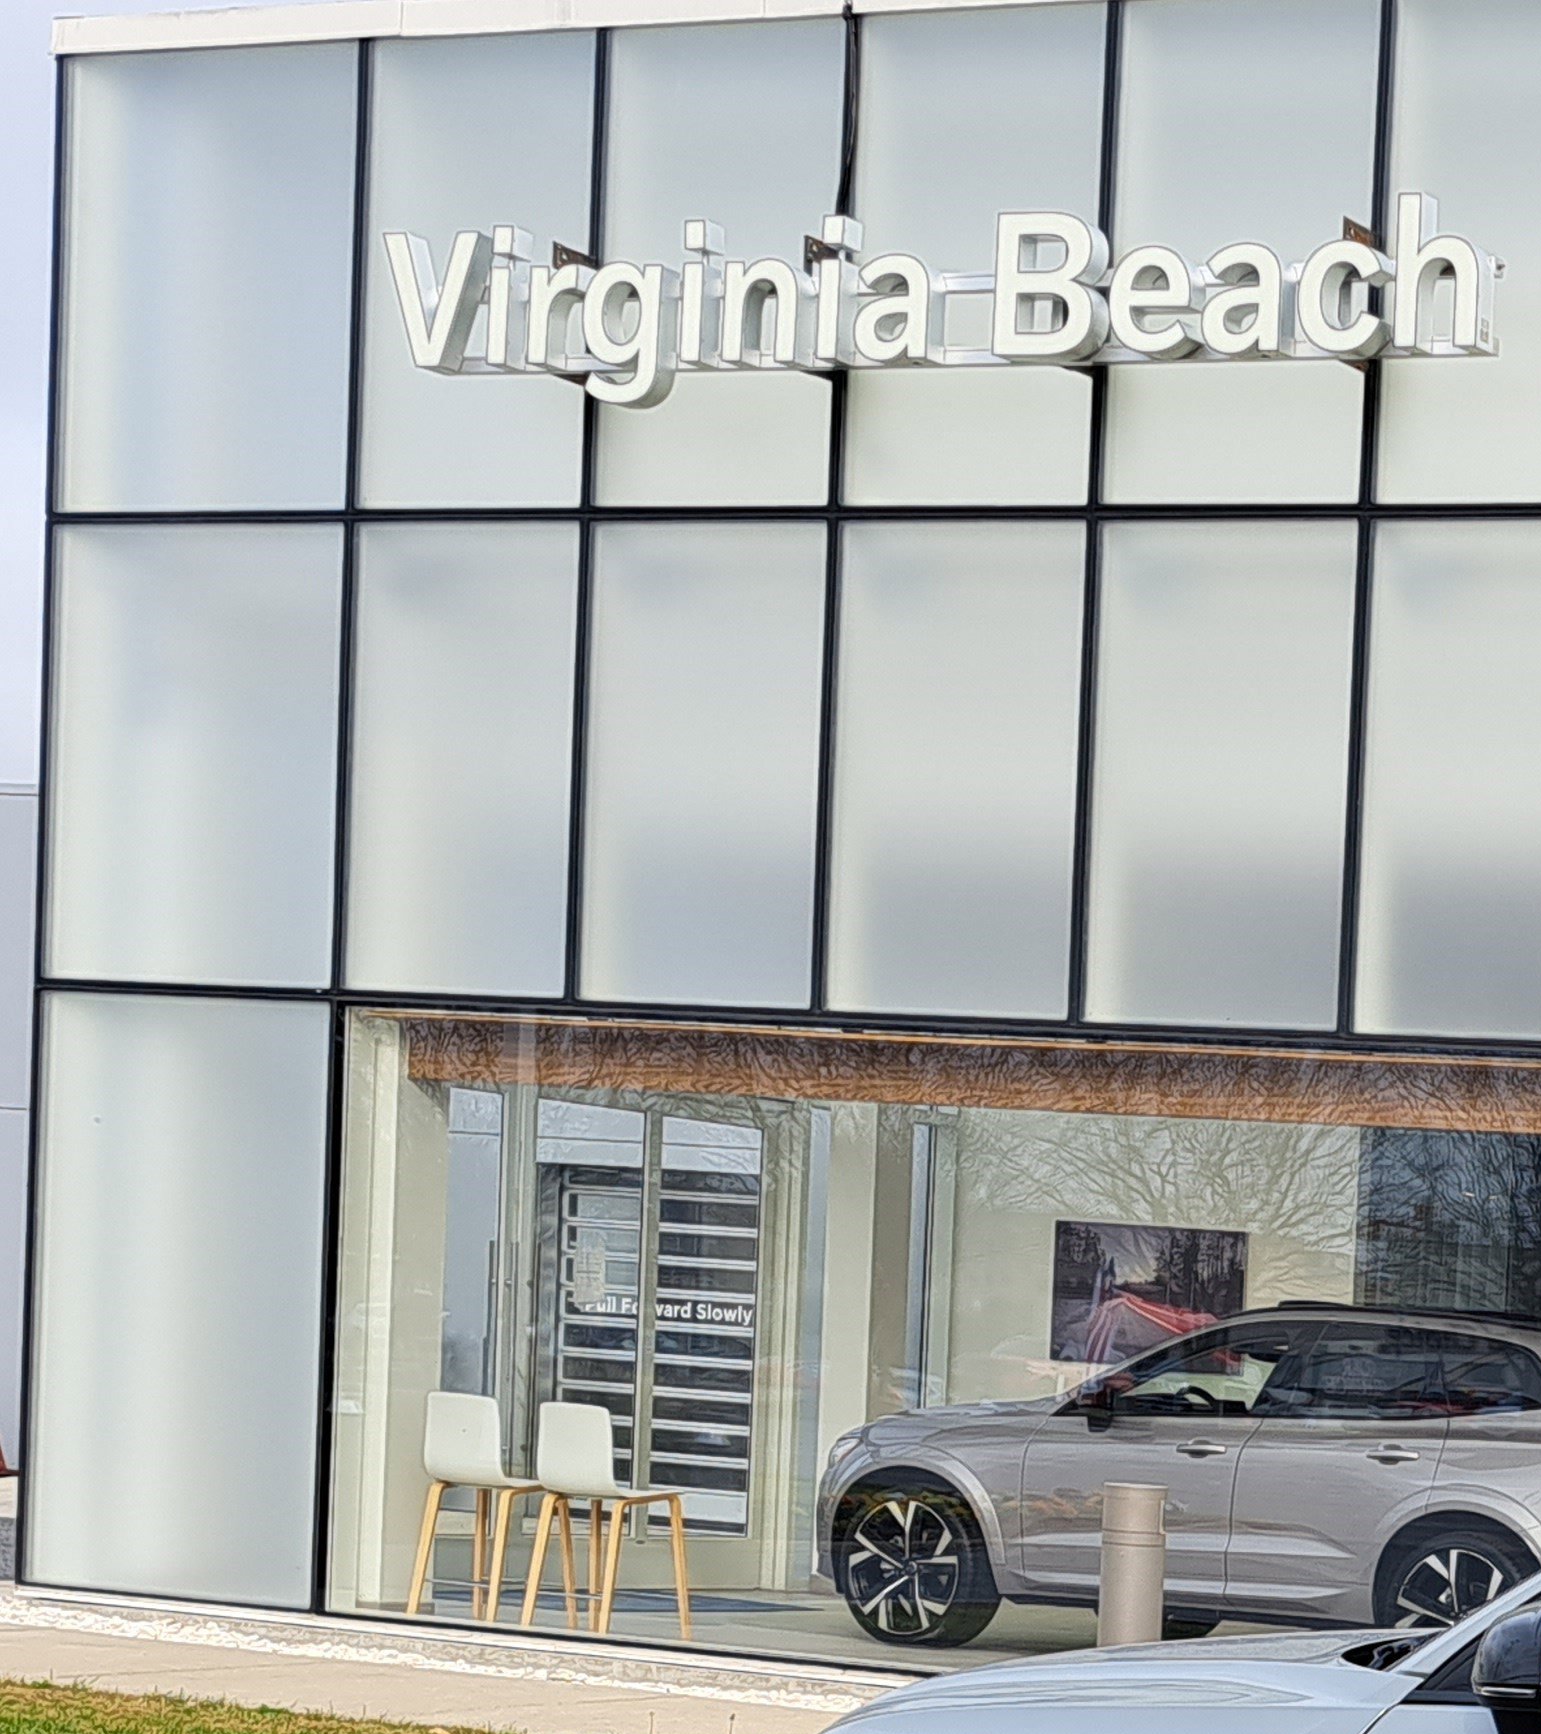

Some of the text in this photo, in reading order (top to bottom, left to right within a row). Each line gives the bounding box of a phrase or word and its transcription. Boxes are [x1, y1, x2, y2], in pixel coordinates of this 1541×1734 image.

[383, 191, 1492, 406] Virginia Beach
[621, 1298, 692, 1319] Foward
[696, 1303, 753, 1326] Slowly
